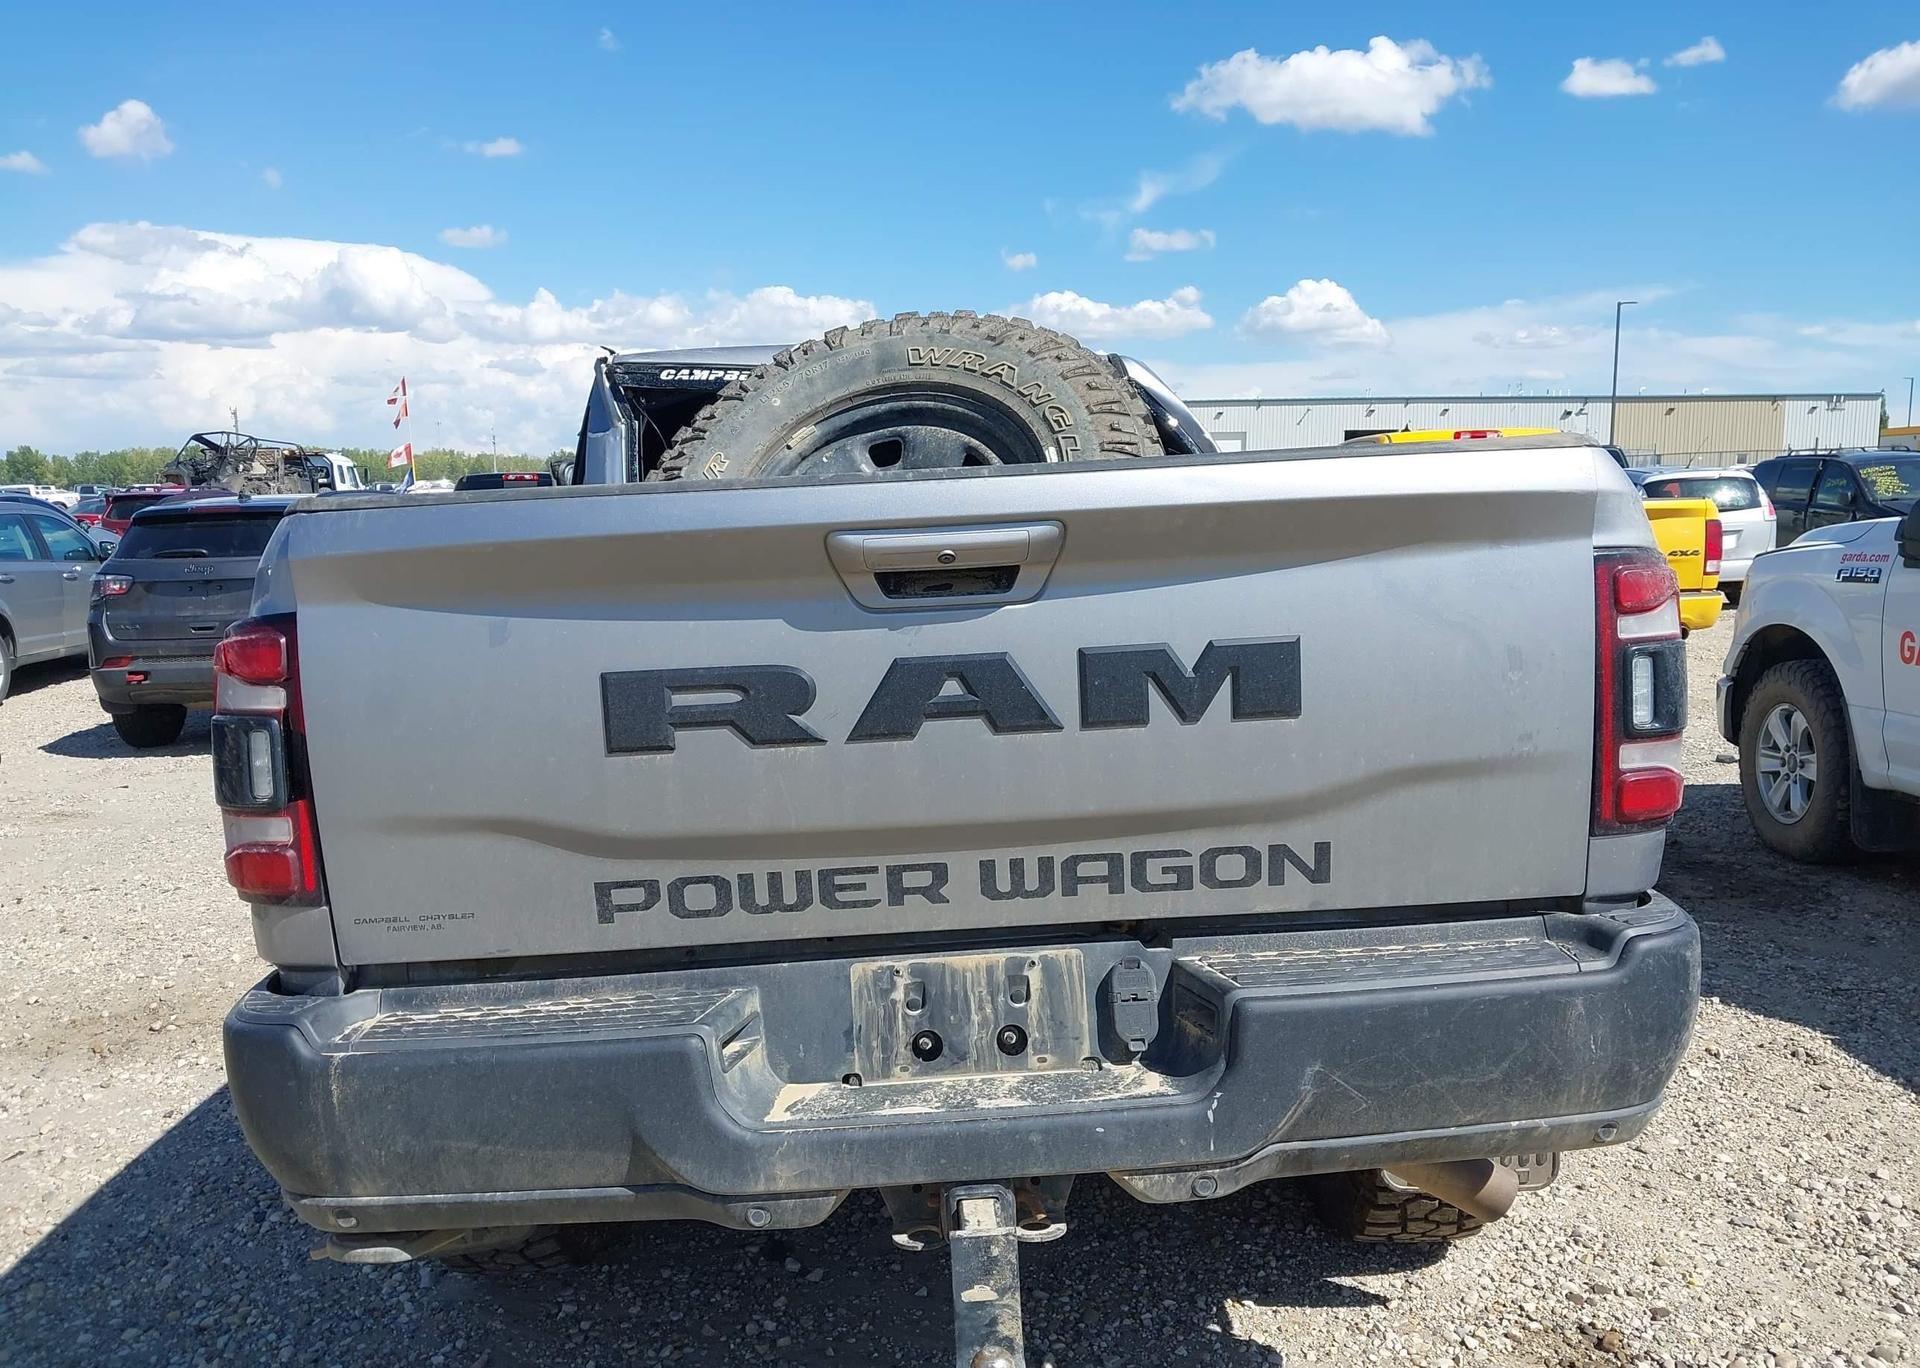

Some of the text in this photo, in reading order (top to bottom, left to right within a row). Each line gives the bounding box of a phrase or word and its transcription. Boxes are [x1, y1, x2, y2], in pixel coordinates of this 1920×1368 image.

[1841, 551, 1890, 564] garda.com
[1900, 631, 1920, 667] G
[600, 635, 1301, 757] RAM
[593, 841, 1332, 924] POWER WAGON
[353, 912, 476, 925] CAMPBELL CHRYSLER
[386, 923, 429, 934] FAIRVIEW,
